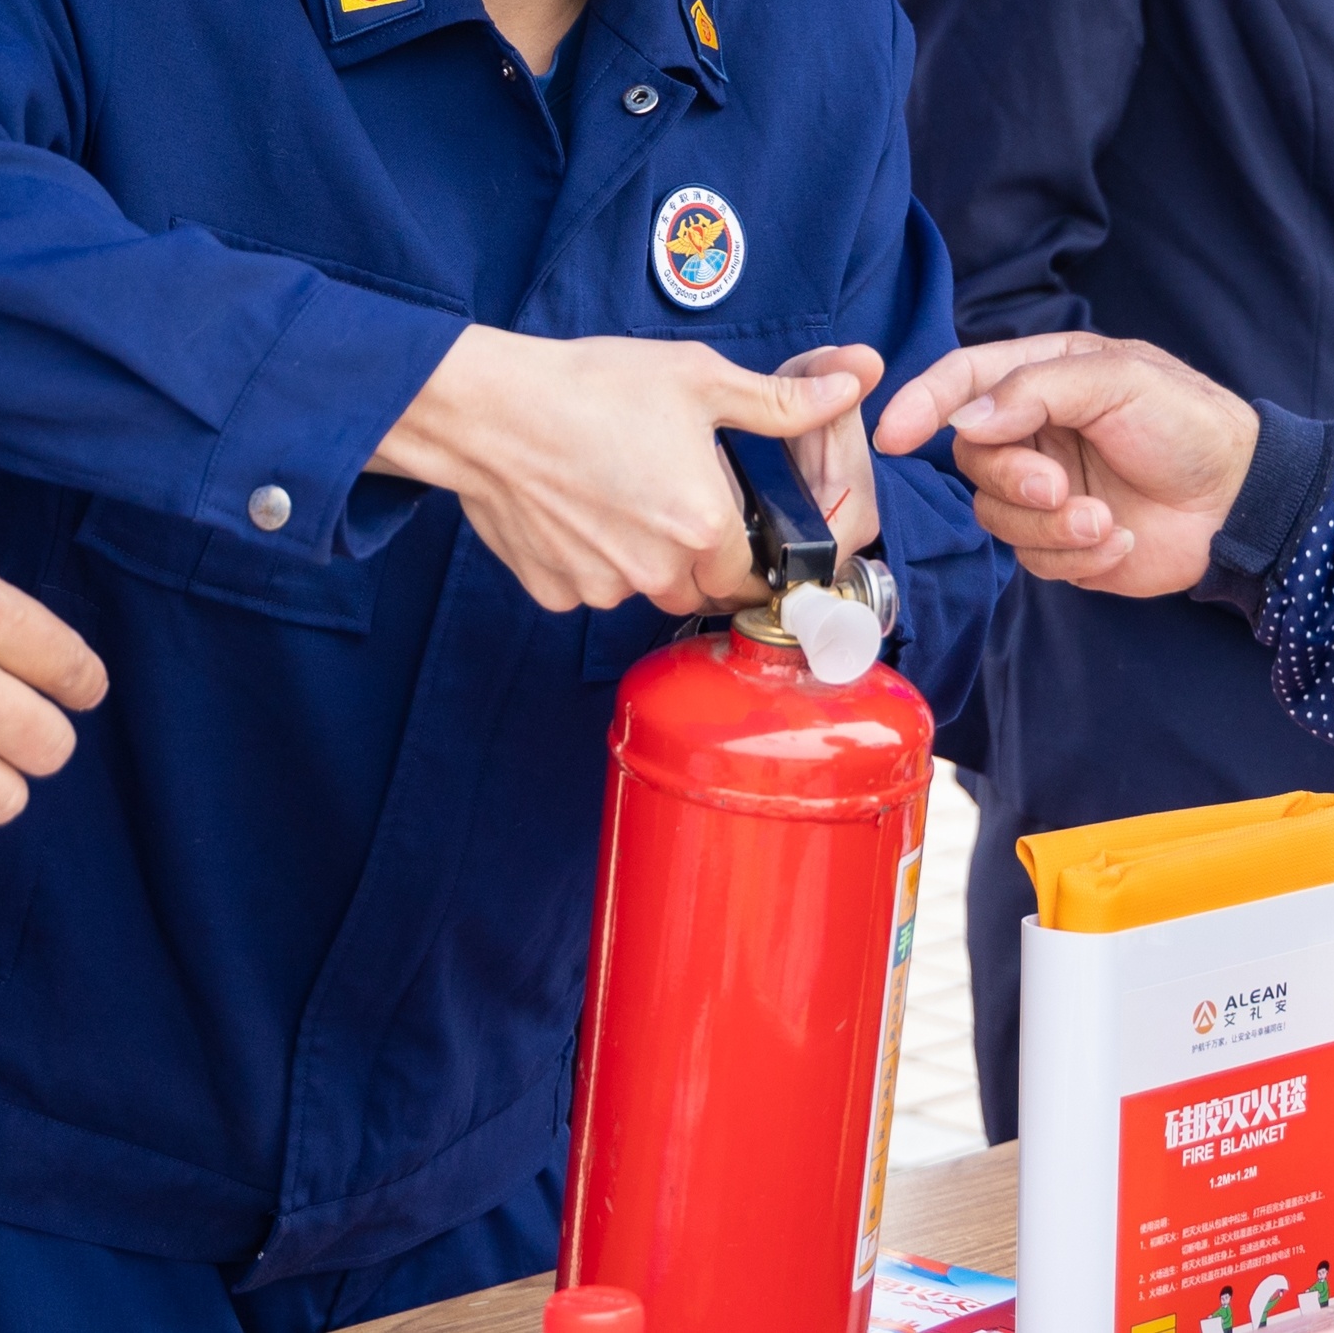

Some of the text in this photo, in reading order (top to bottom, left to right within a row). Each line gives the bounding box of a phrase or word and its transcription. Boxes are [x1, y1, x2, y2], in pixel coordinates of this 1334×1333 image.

[663, 240, 741, 302] Guangdong Career Firefighter
[1223, 981, 1288, 1012] ALEAN
[1223, 999, 1288, 1028] 艾礼安
[1164, 1074, 1308, 1150] 硅胶灭火毯
[1181, 1122, 1288, 1167] FIRE BLANKET
